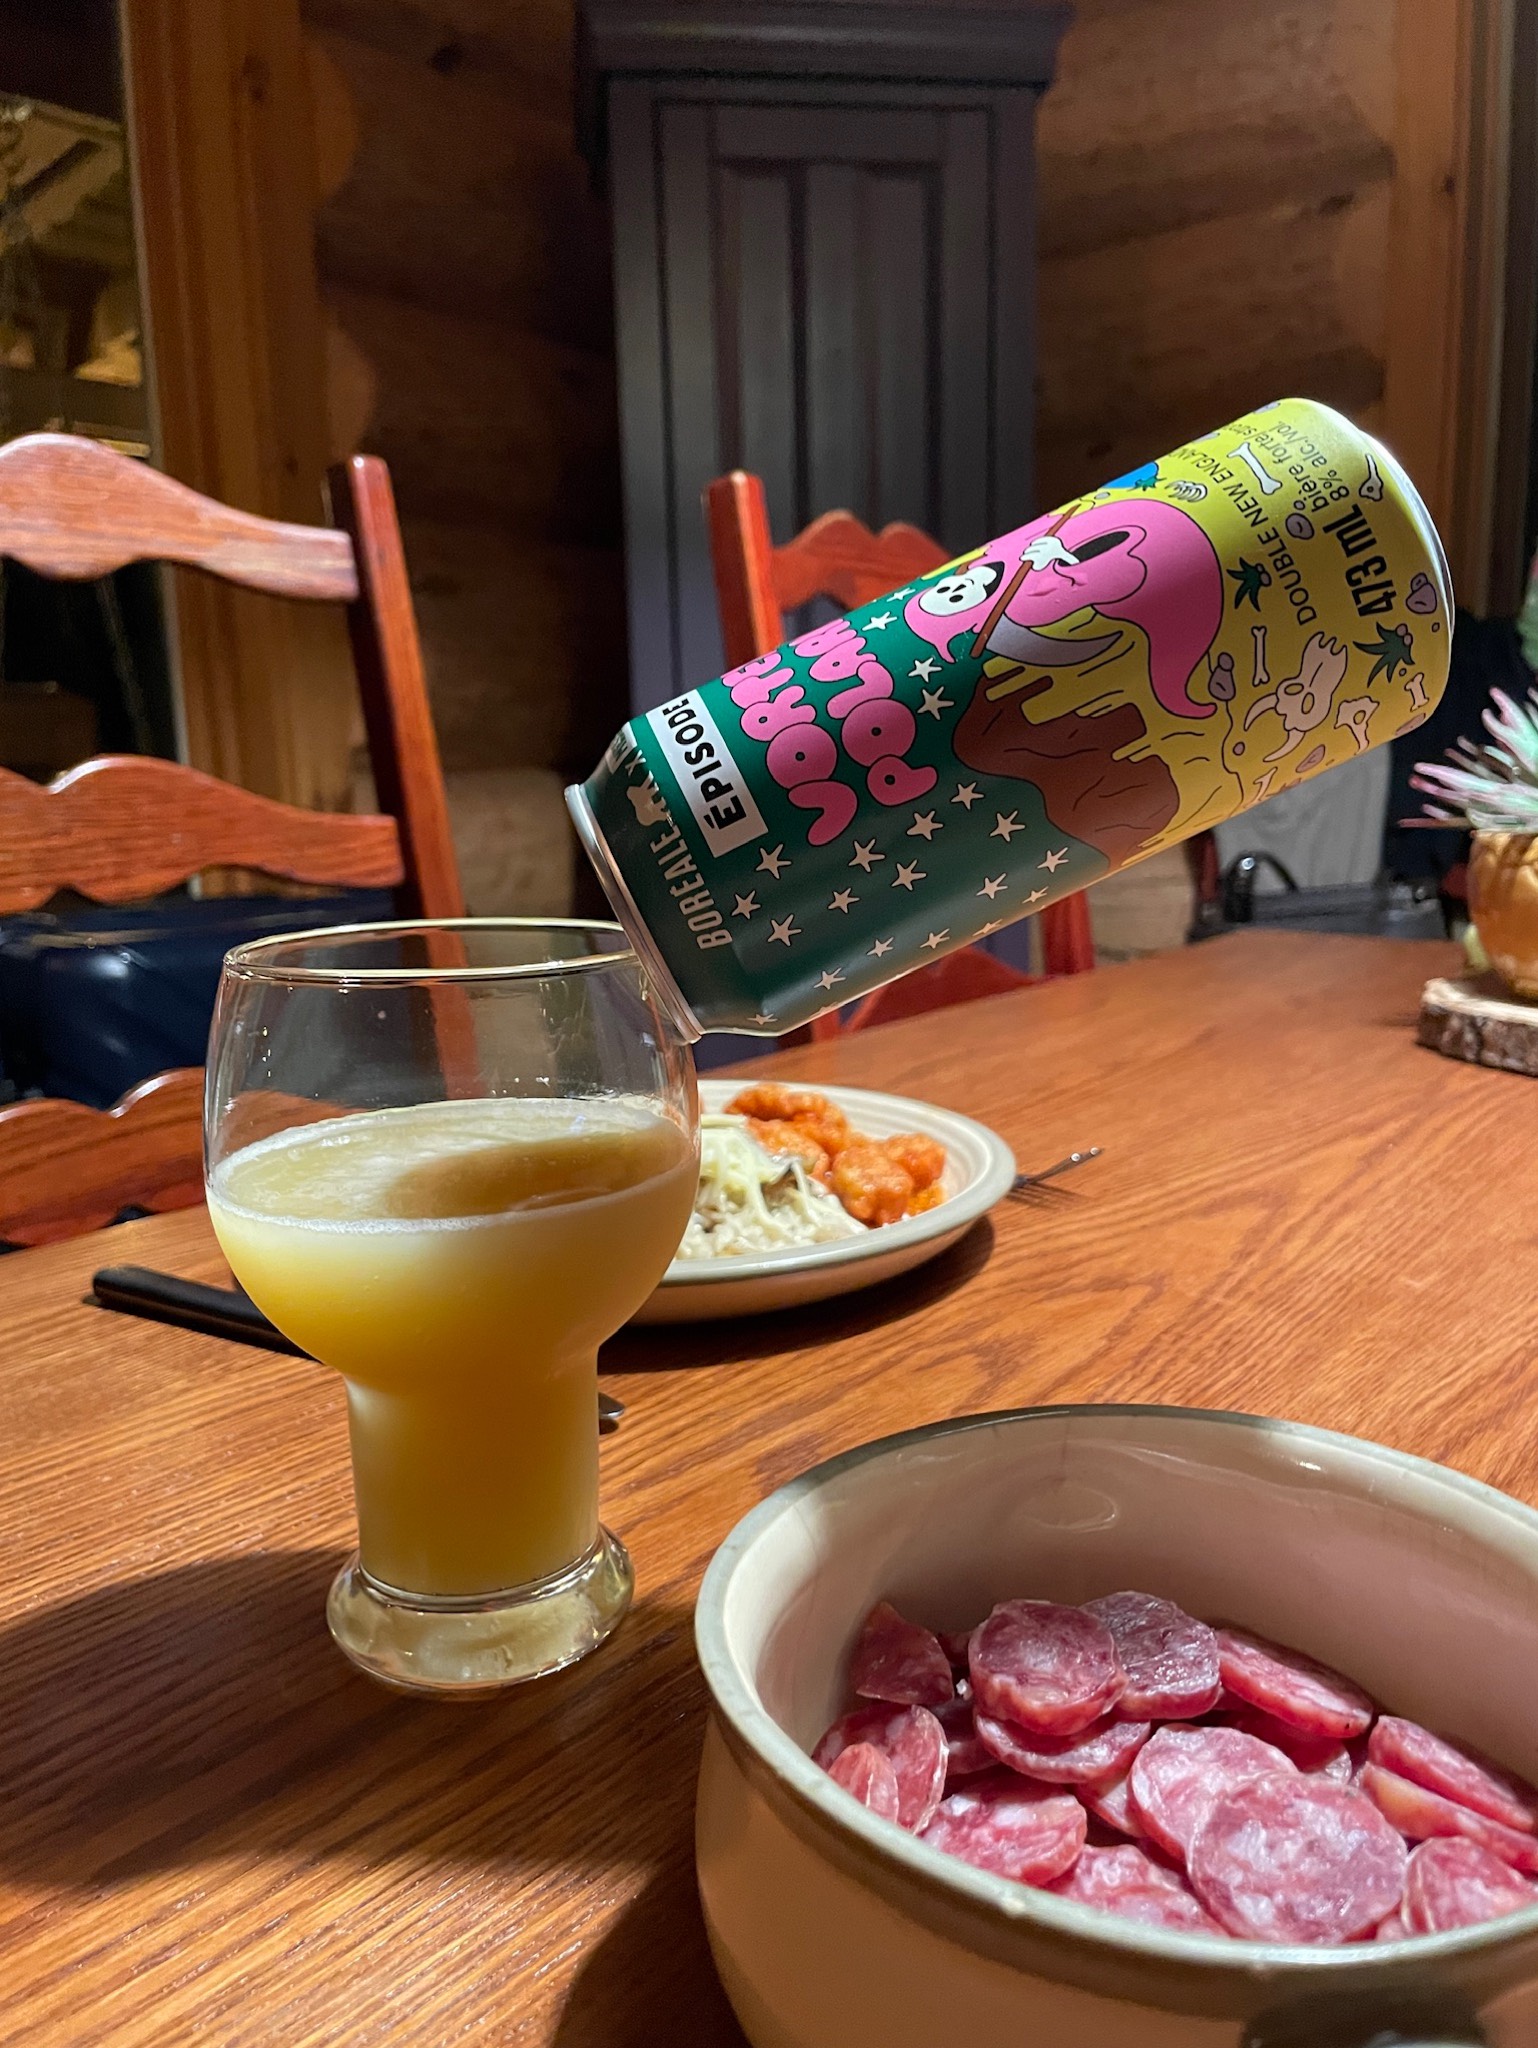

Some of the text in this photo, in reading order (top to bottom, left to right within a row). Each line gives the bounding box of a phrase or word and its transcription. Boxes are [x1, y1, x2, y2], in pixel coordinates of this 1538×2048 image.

[1289, 464, 1328, 513] bière
[1318, 468, 1350, 503] 8%
[1168, 447, 1317, 626] DOUBLE NEW ENGLAN
[1344, 555, 1398, 617] 473
[662, 698, 747, 830] ÉPISODE
[720, 650, 858, 847] VORTE
